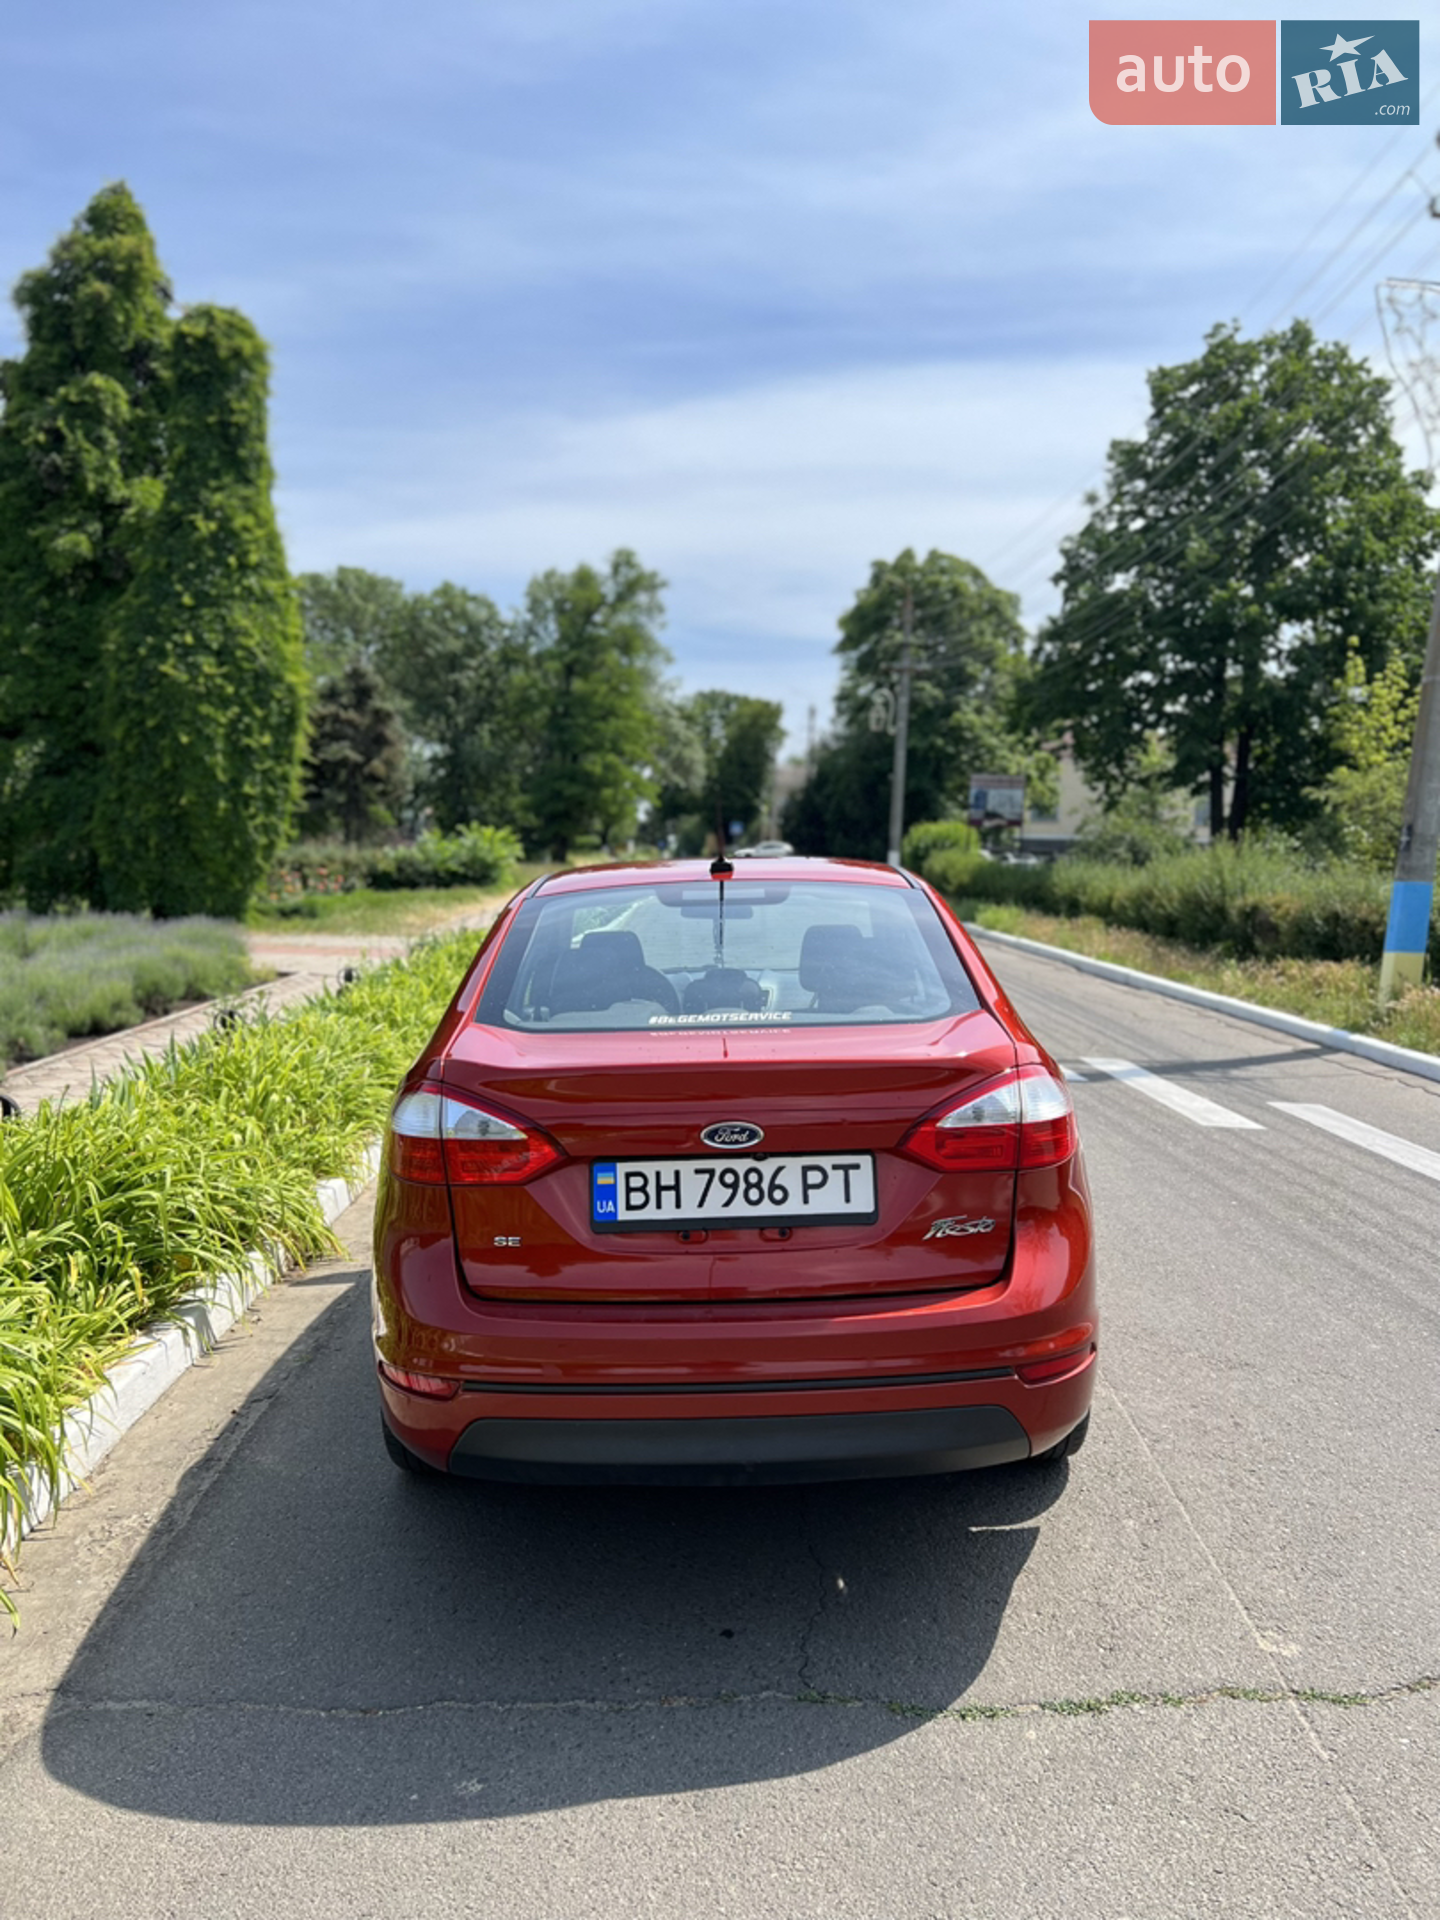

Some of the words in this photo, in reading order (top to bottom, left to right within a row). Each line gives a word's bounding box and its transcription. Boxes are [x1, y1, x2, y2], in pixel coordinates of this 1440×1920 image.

[714, 1127, 750, 1142] Ford
[625, 1169, 681, 1212] BH
[694, 1165, 789, 1208] 7986
[801, 1163, 861, 1204] PT
[597, 1200, 616, 1214] UA
[493, 1236, 522, 1247] SE
